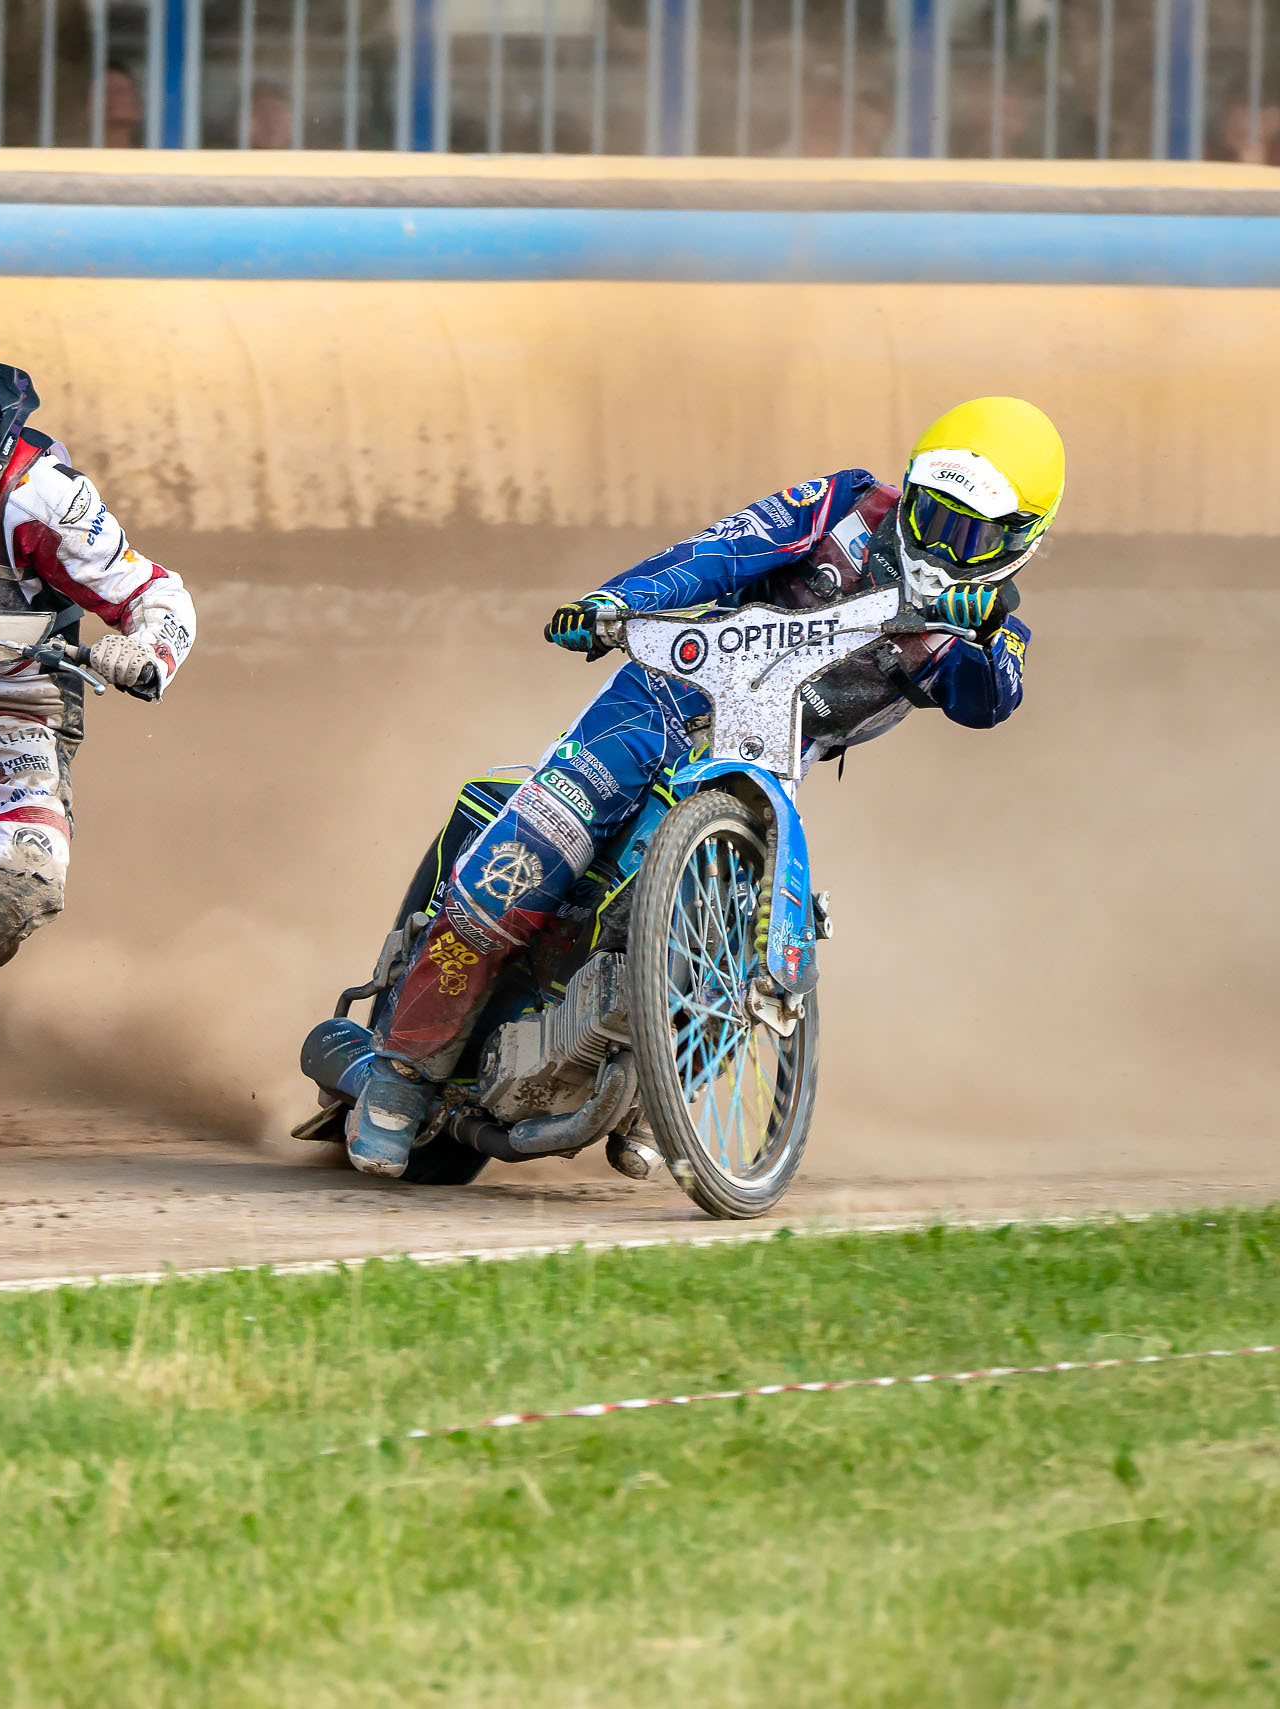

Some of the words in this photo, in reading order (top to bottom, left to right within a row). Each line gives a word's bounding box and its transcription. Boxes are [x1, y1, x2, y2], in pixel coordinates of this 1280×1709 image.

[937, 470, 976, 493] SHOEI
[717, 619, 840, 654] OPTIBET
[720, 651, 781, 664] SPORTA
[794, 647, 835, 657] BARS
[569, 755, 614, 801] REALITY
[579, 748, 620, 794] PERSONAL
[547, 773, 594, 815] stuha
[429, 938, 464, 975] TEC
[440, 930, 479, 965] PRO
